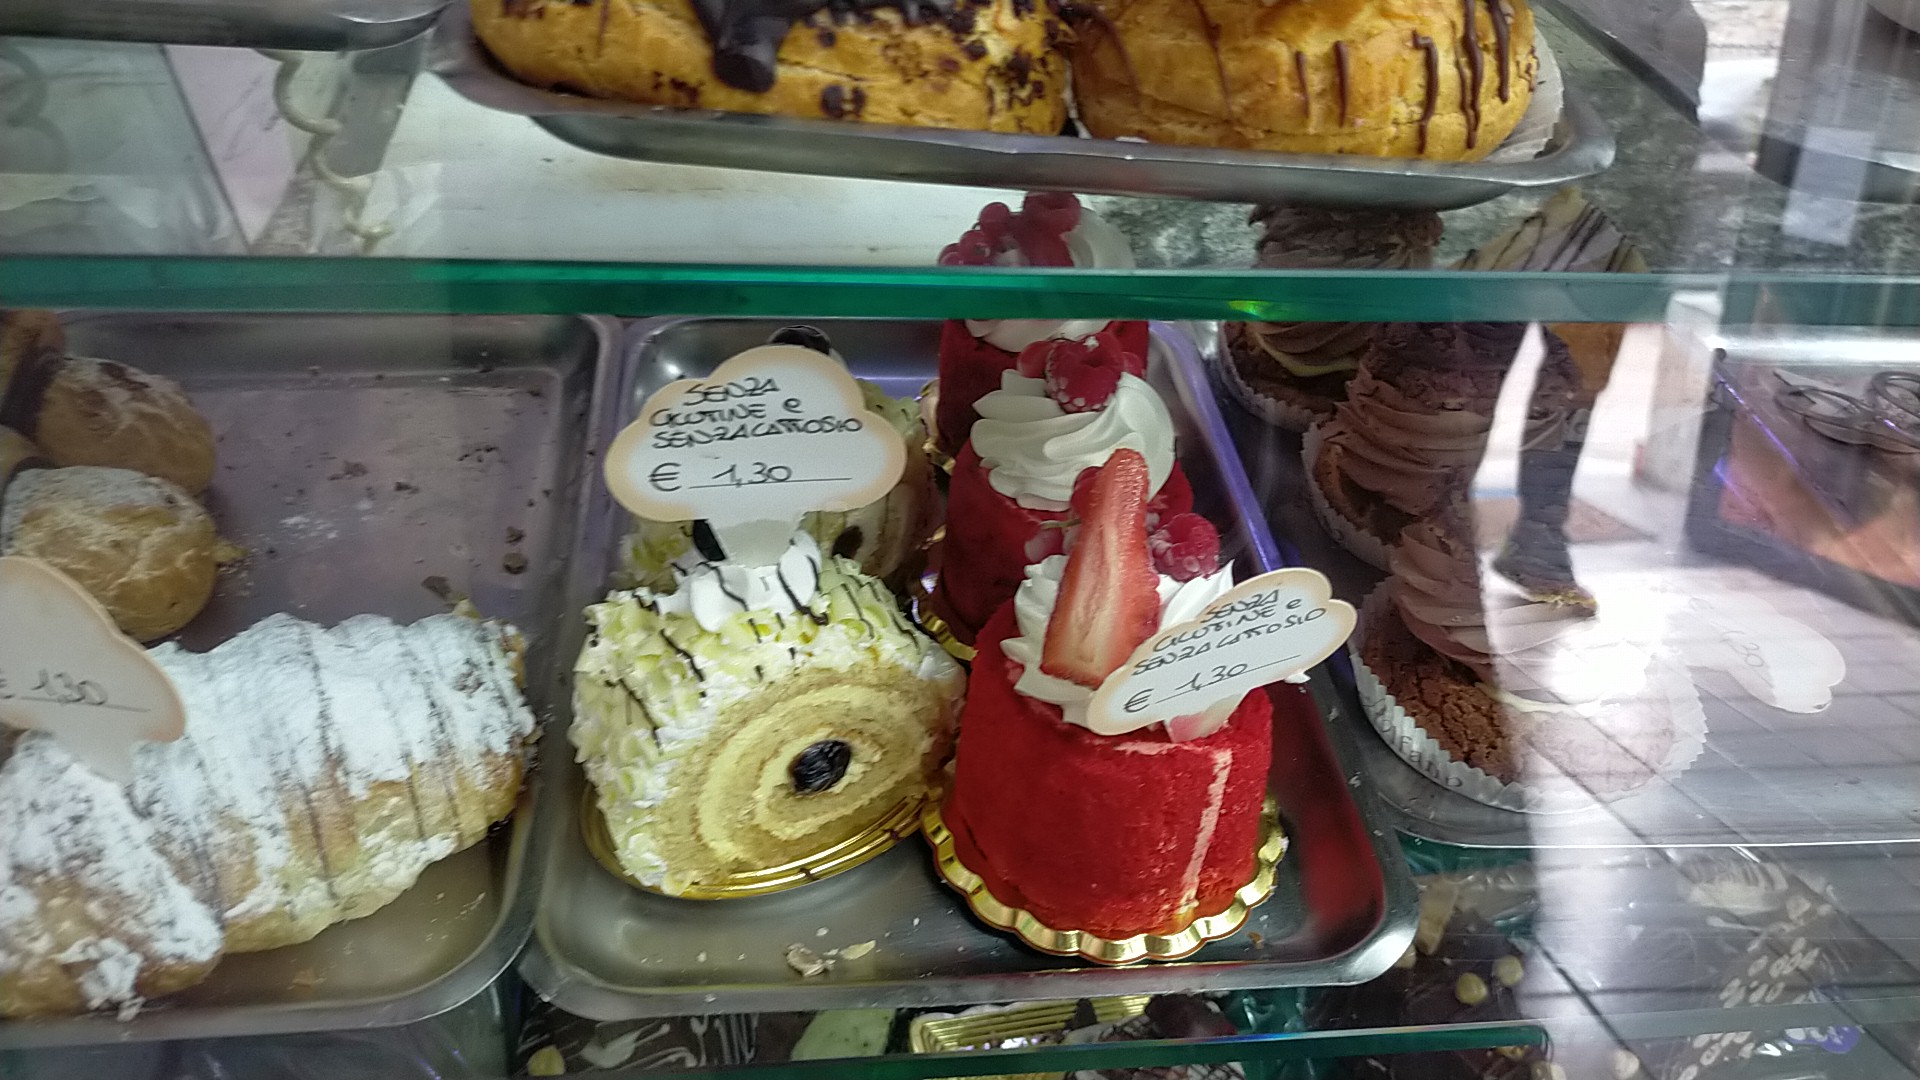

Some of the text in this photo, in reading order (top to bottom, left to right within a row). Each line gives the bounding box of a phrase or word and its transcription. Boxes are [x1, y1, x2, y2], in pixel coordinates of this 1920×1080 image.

[683, 377, 781, 406] SENZA
[652, 423, 750, 449] SENZA
[648, 462, 794, 492] € 1,30
[1200, 589, 1279, 624] SENZA
[1132, 642, 1211, 676] SENZA
[29, 667, 109, 708] 1,30
[1123, 662, 1249, 713] € 1,30
